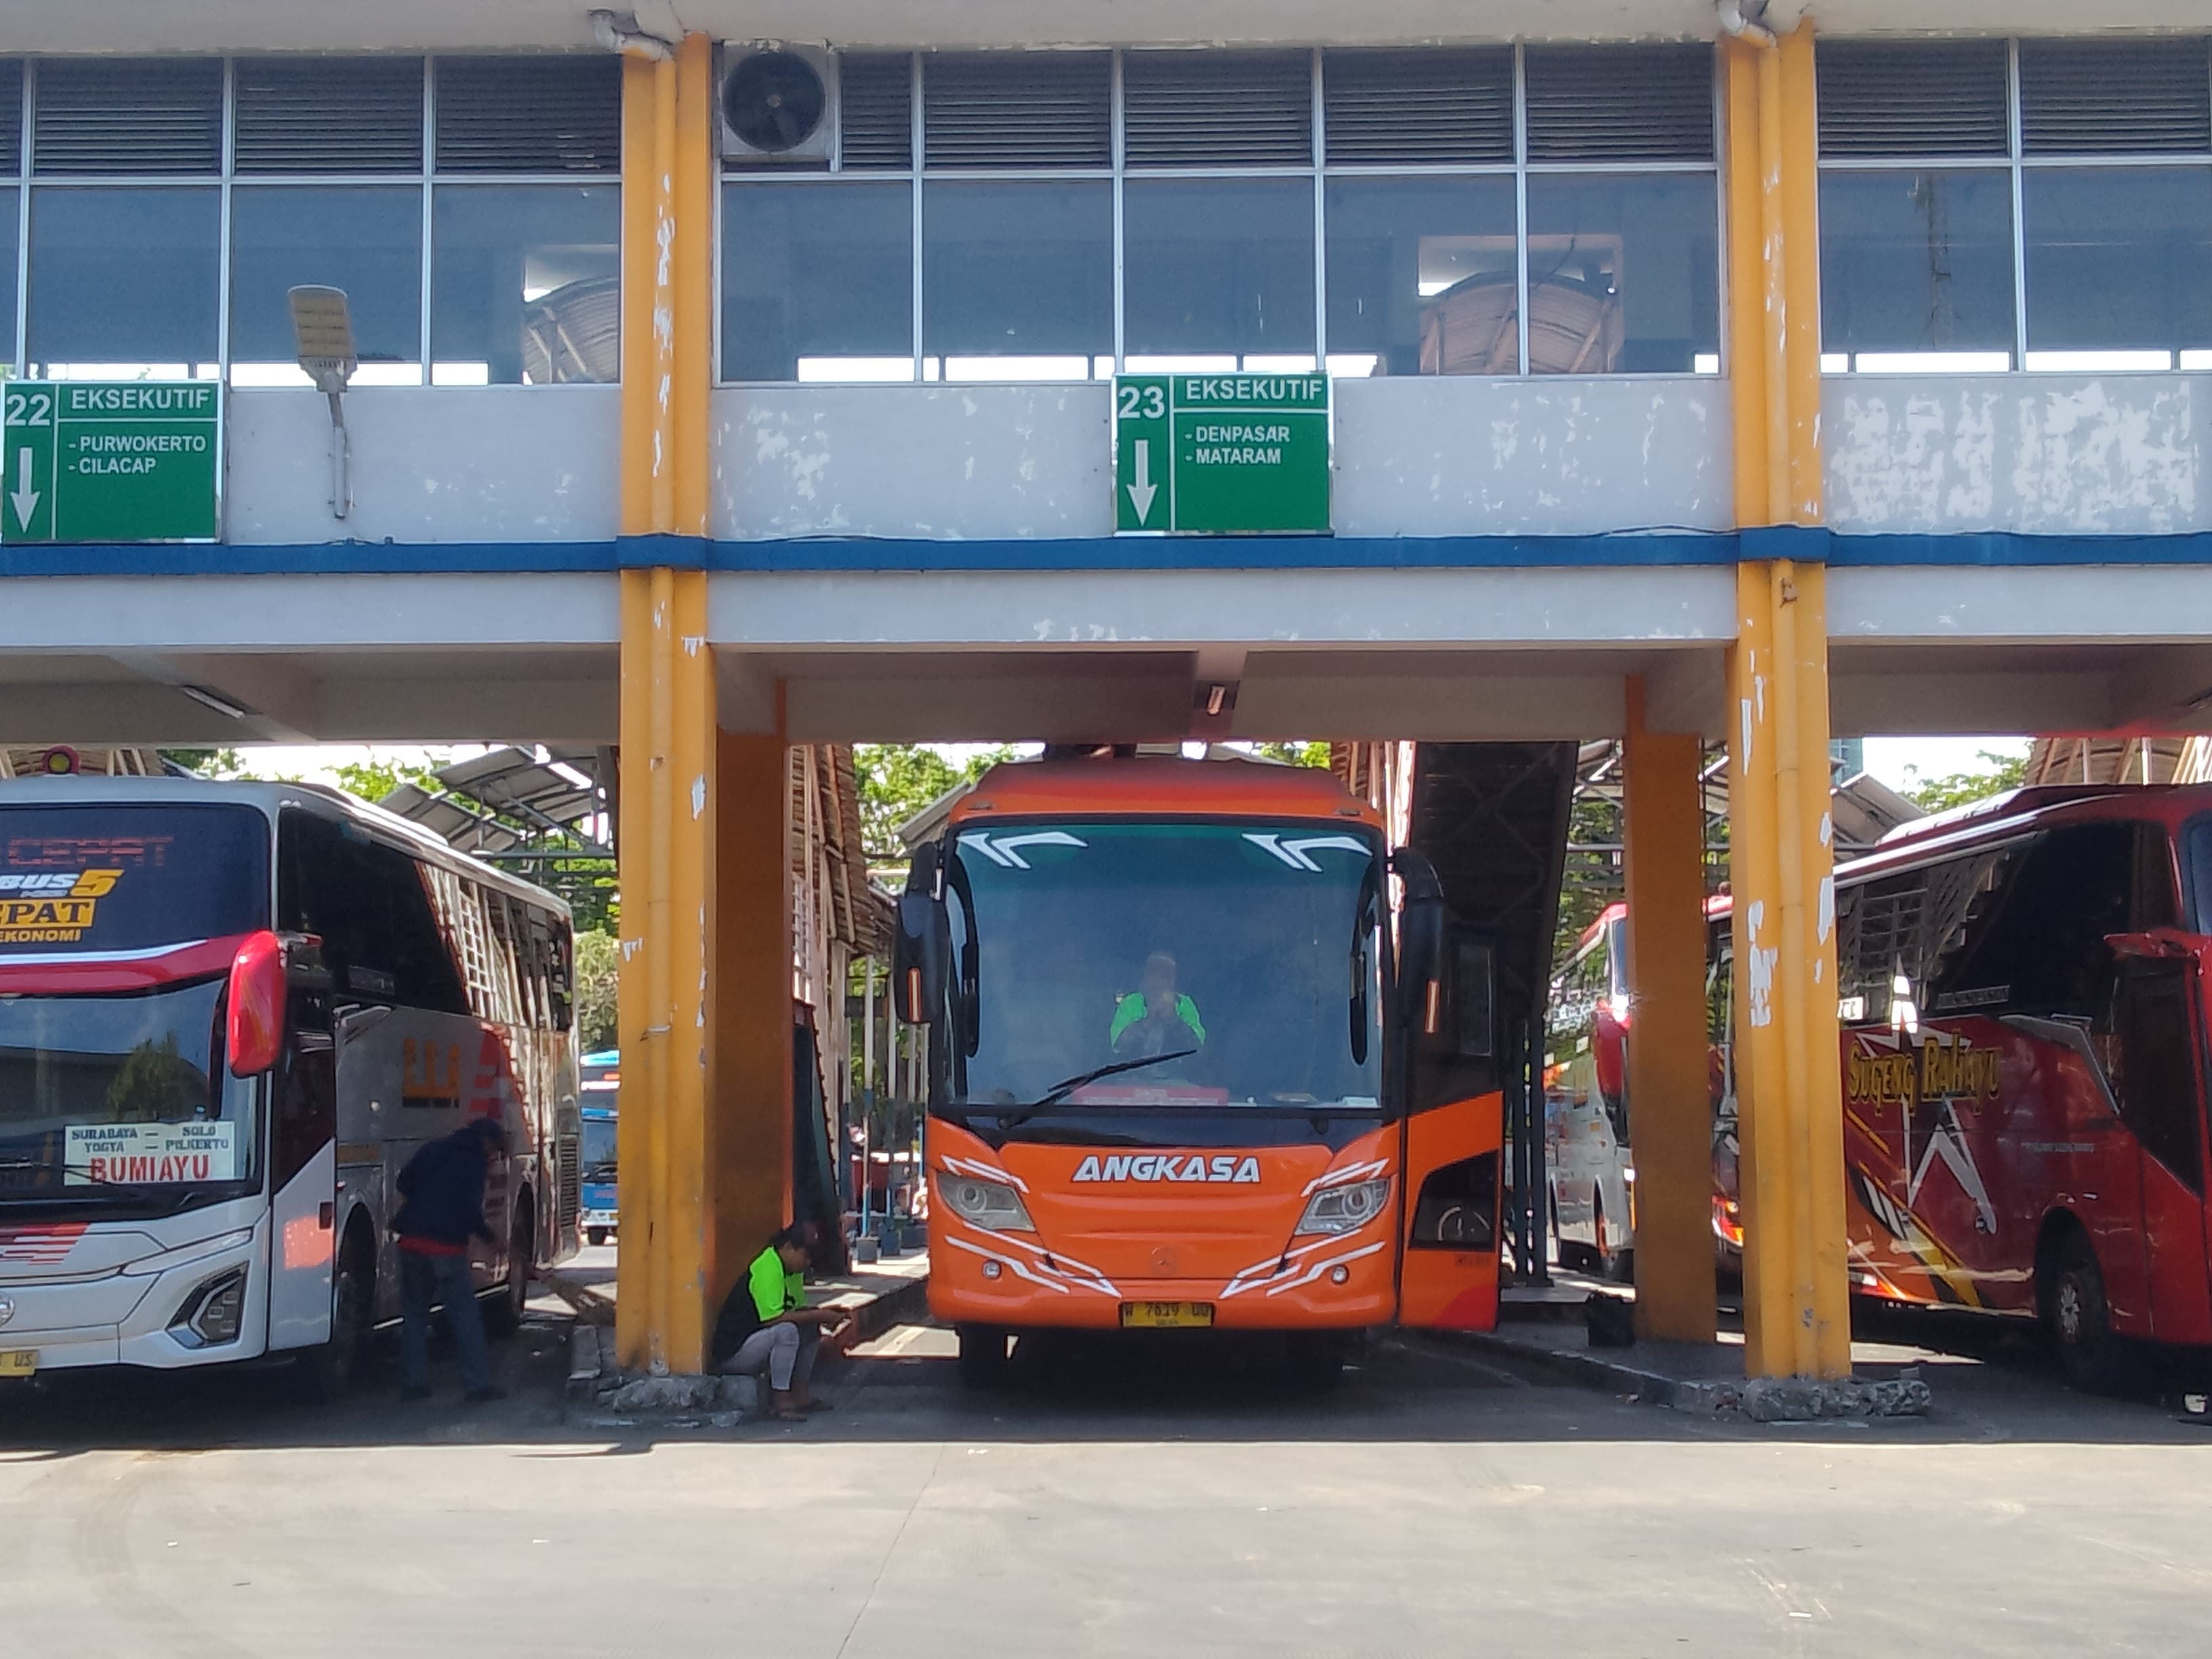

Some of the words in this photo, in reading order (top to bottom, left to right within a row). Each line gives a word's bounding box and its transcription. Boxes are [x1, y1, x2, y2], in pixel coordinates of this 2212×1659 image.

[71, 388, 210, 410] EKSEKUTIF
[1186, 379, 1323, 400] EKSEKUTIF
[5, 394, 51, 426] 22
[1118, 386, 1165, 419] 23
[0, 901, 90, 925] PAT
[71, 1127, 138, 1141] SURABAYA
[182, 1126, 216, 1137] SOLO
[84, 1141, 125, 1153] YOGYA
[90, 1154, 209, 1183] BUMIAYU
[1072, 1155, 1261, 1182] ANGKASA
